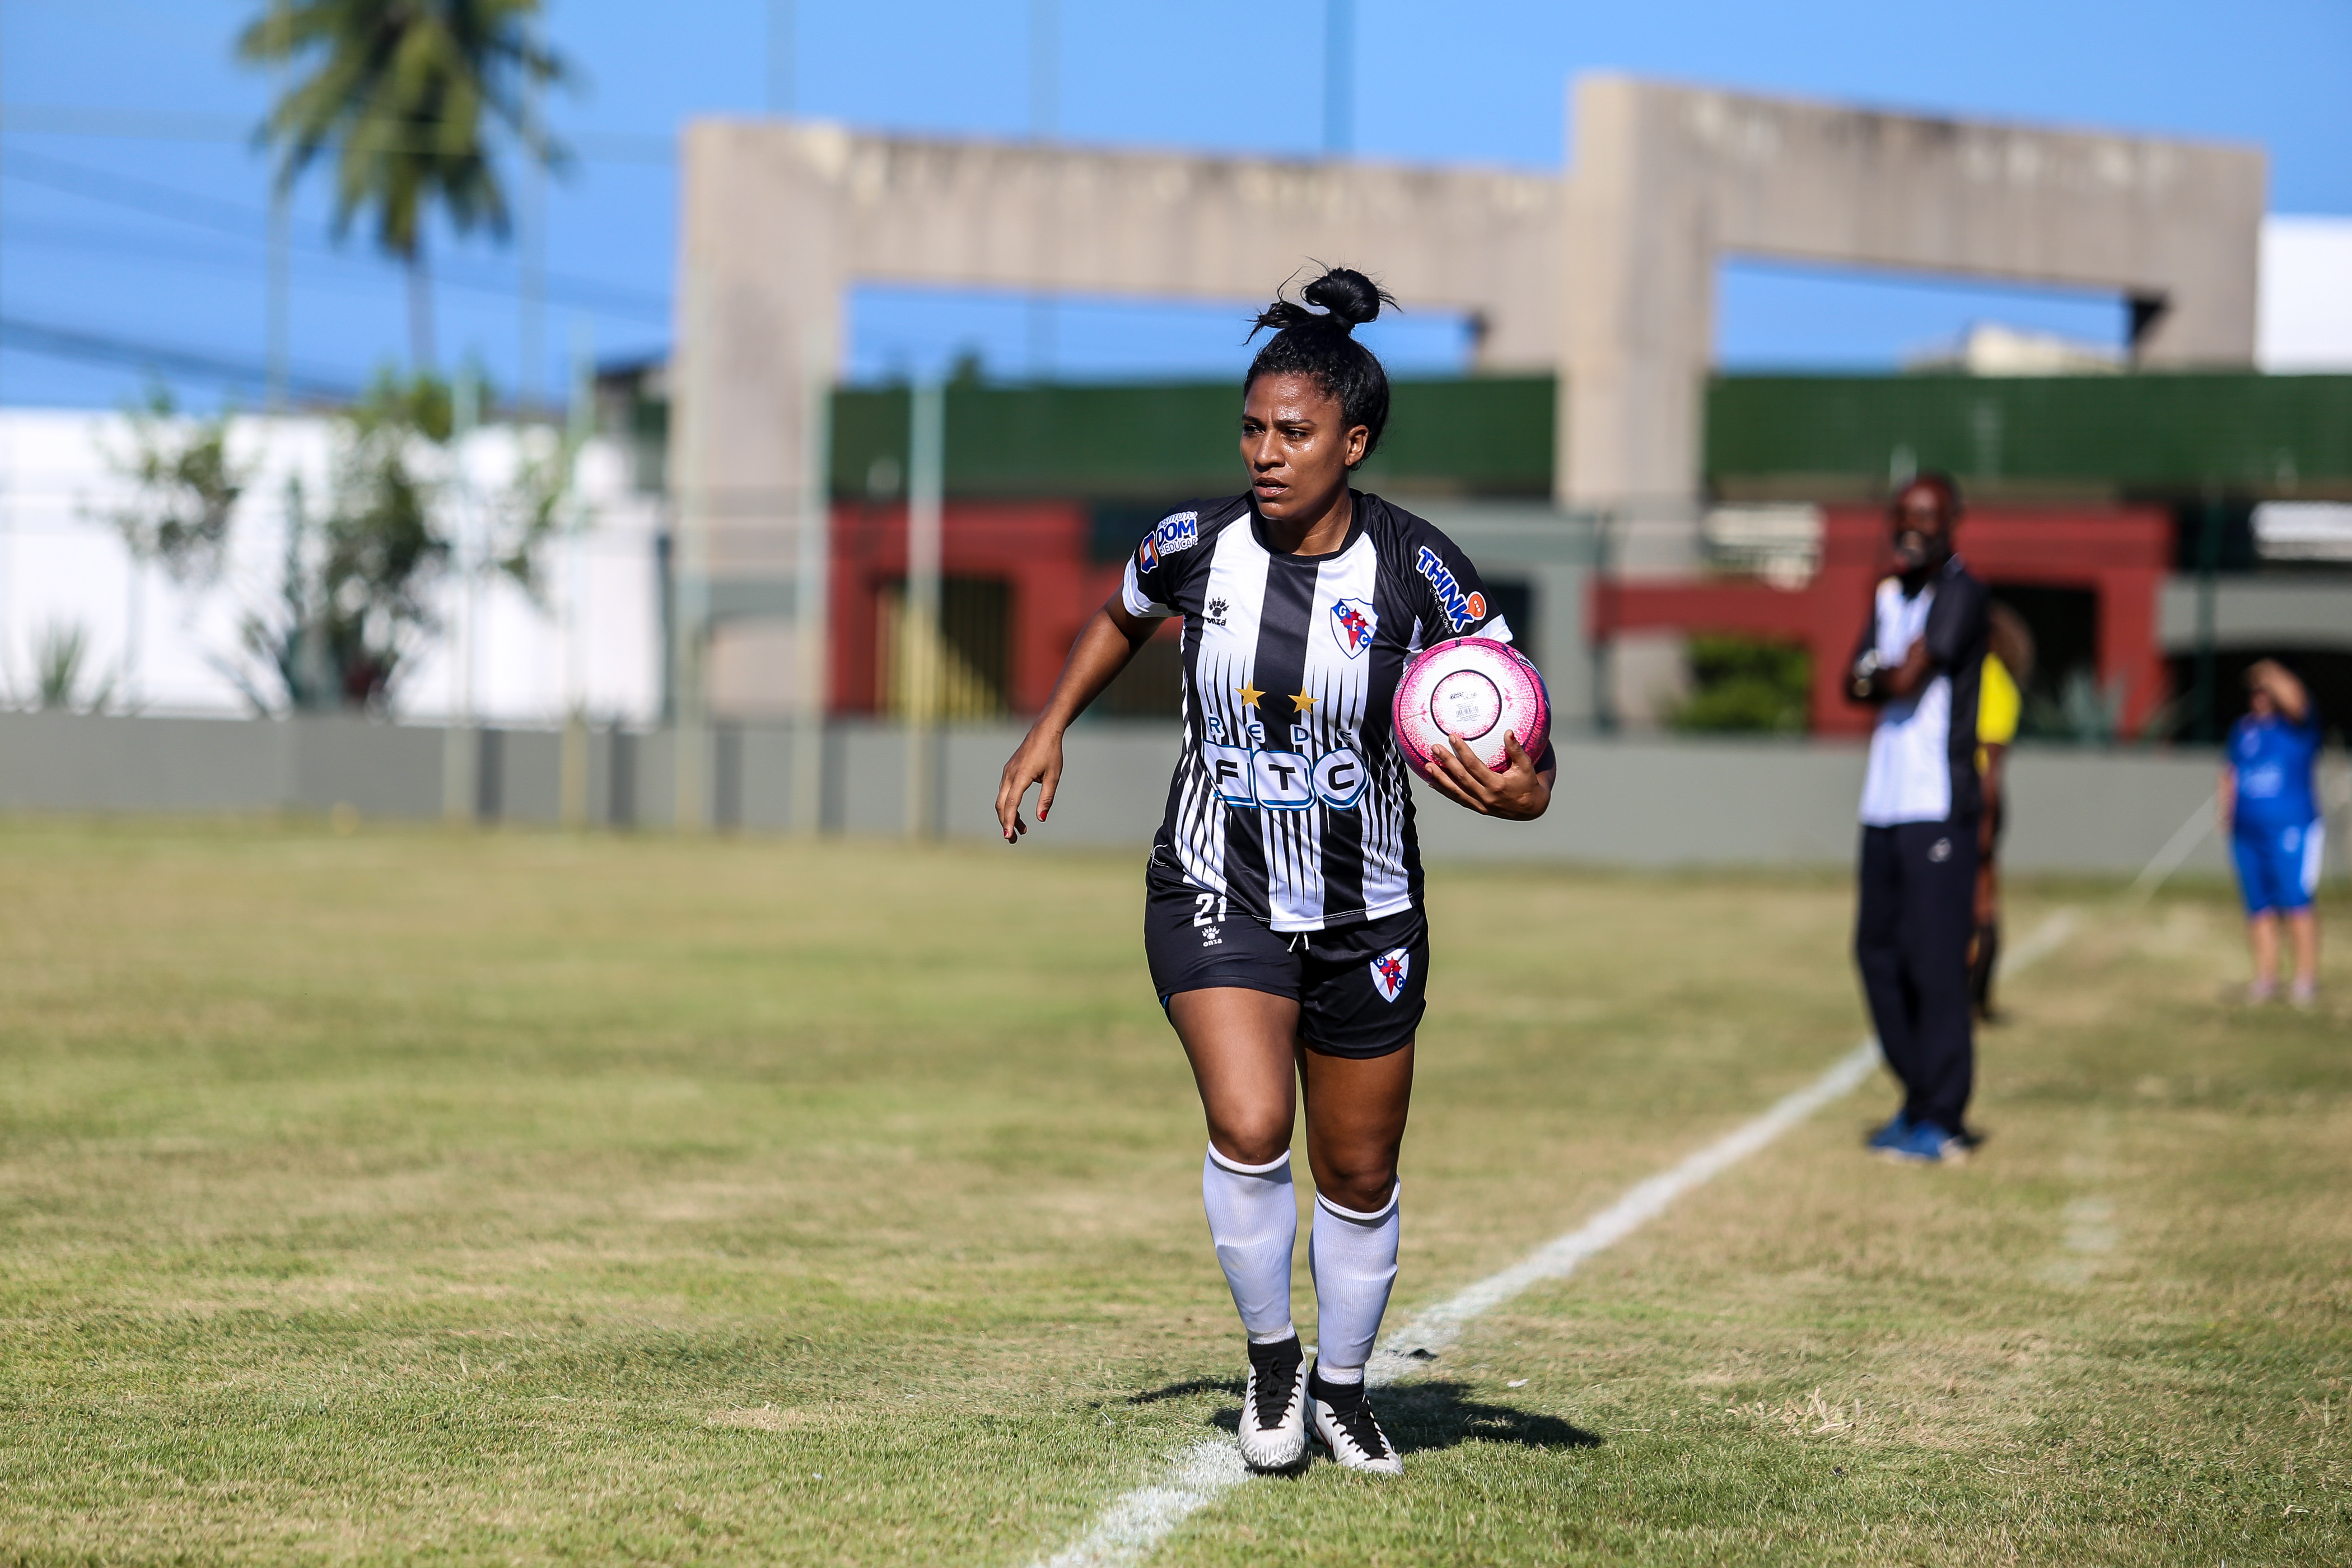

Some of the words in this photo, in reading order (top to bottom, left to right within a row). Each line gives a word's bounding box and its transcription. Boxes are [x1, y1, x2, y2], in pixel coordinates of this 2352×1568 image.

[1156, 519, 1196, 548] DOM
[1157, 512, 1197, 529] INSTITUTO
[1417, 548, 1474, 631] THINK
[1206, 618, 1227, 626] onza
[1215, 759, 1355, 791] FTC
[1193, 893, 1228, 927] 21
[1203, 938, 1222, 948] onza
